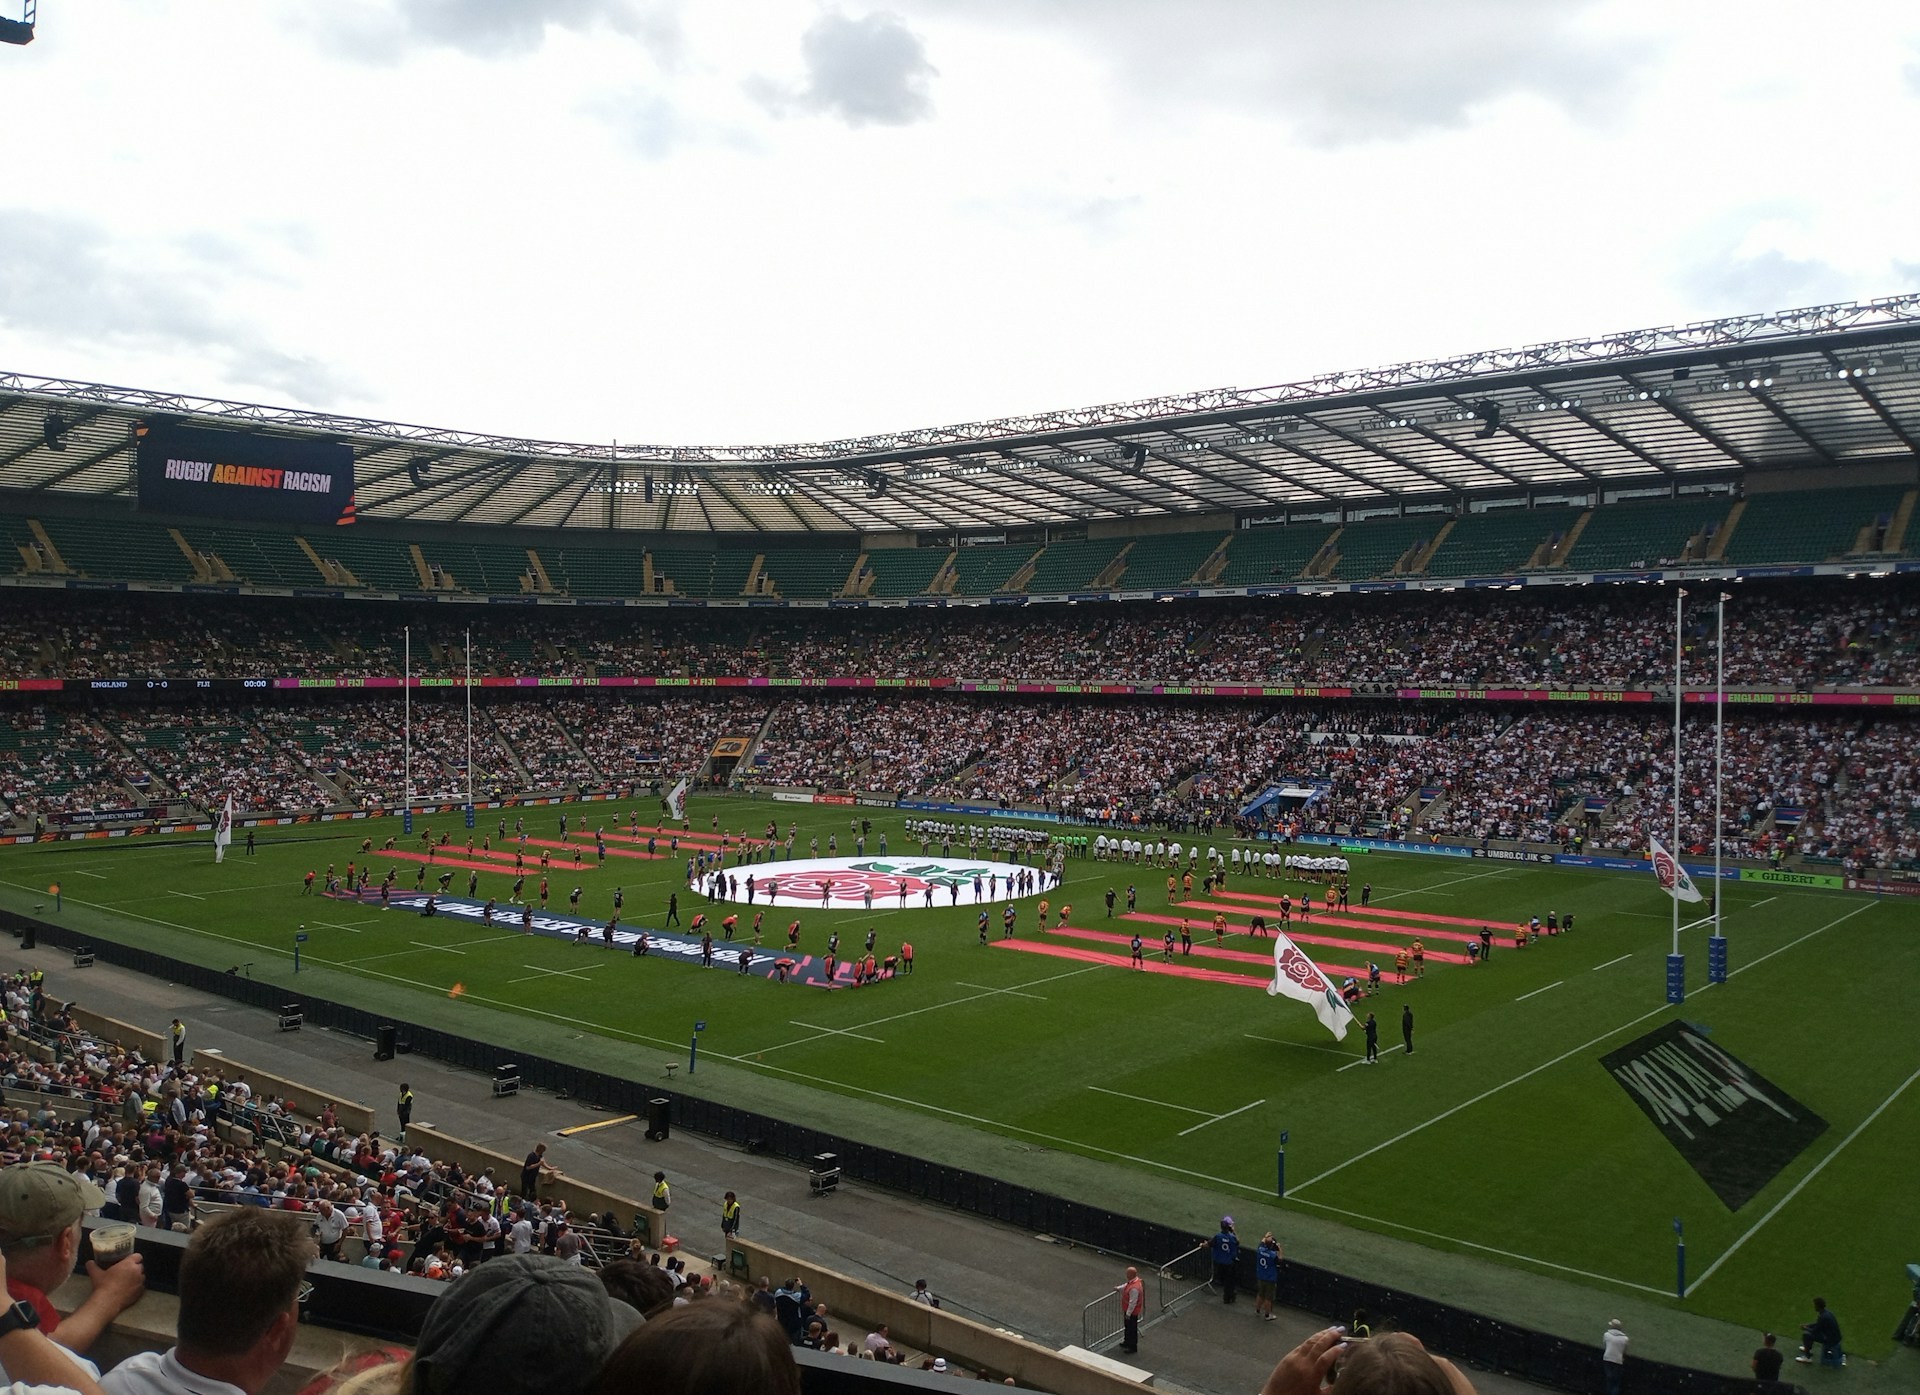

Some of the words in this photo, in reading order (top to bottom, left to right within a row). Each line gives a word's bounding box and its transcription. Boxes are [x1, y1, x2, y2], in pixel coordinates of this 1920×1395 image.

[165, 458, 213, 483] RUGBY
[212, 464, 284, 488] AGAINST
[283, 470, 332, 494] RACISM
[1548, 691, 1590, 700] ENGLAND
[1603, 692, 1622, 701] FIJI
[1728, 694, 1775, 703] ENGLAND
[1790, 694, 1813, 703] FIJI
[1762, 872, 1815, 884] GILBERT
[1614, 1040, 1749, 1140] TikTok
